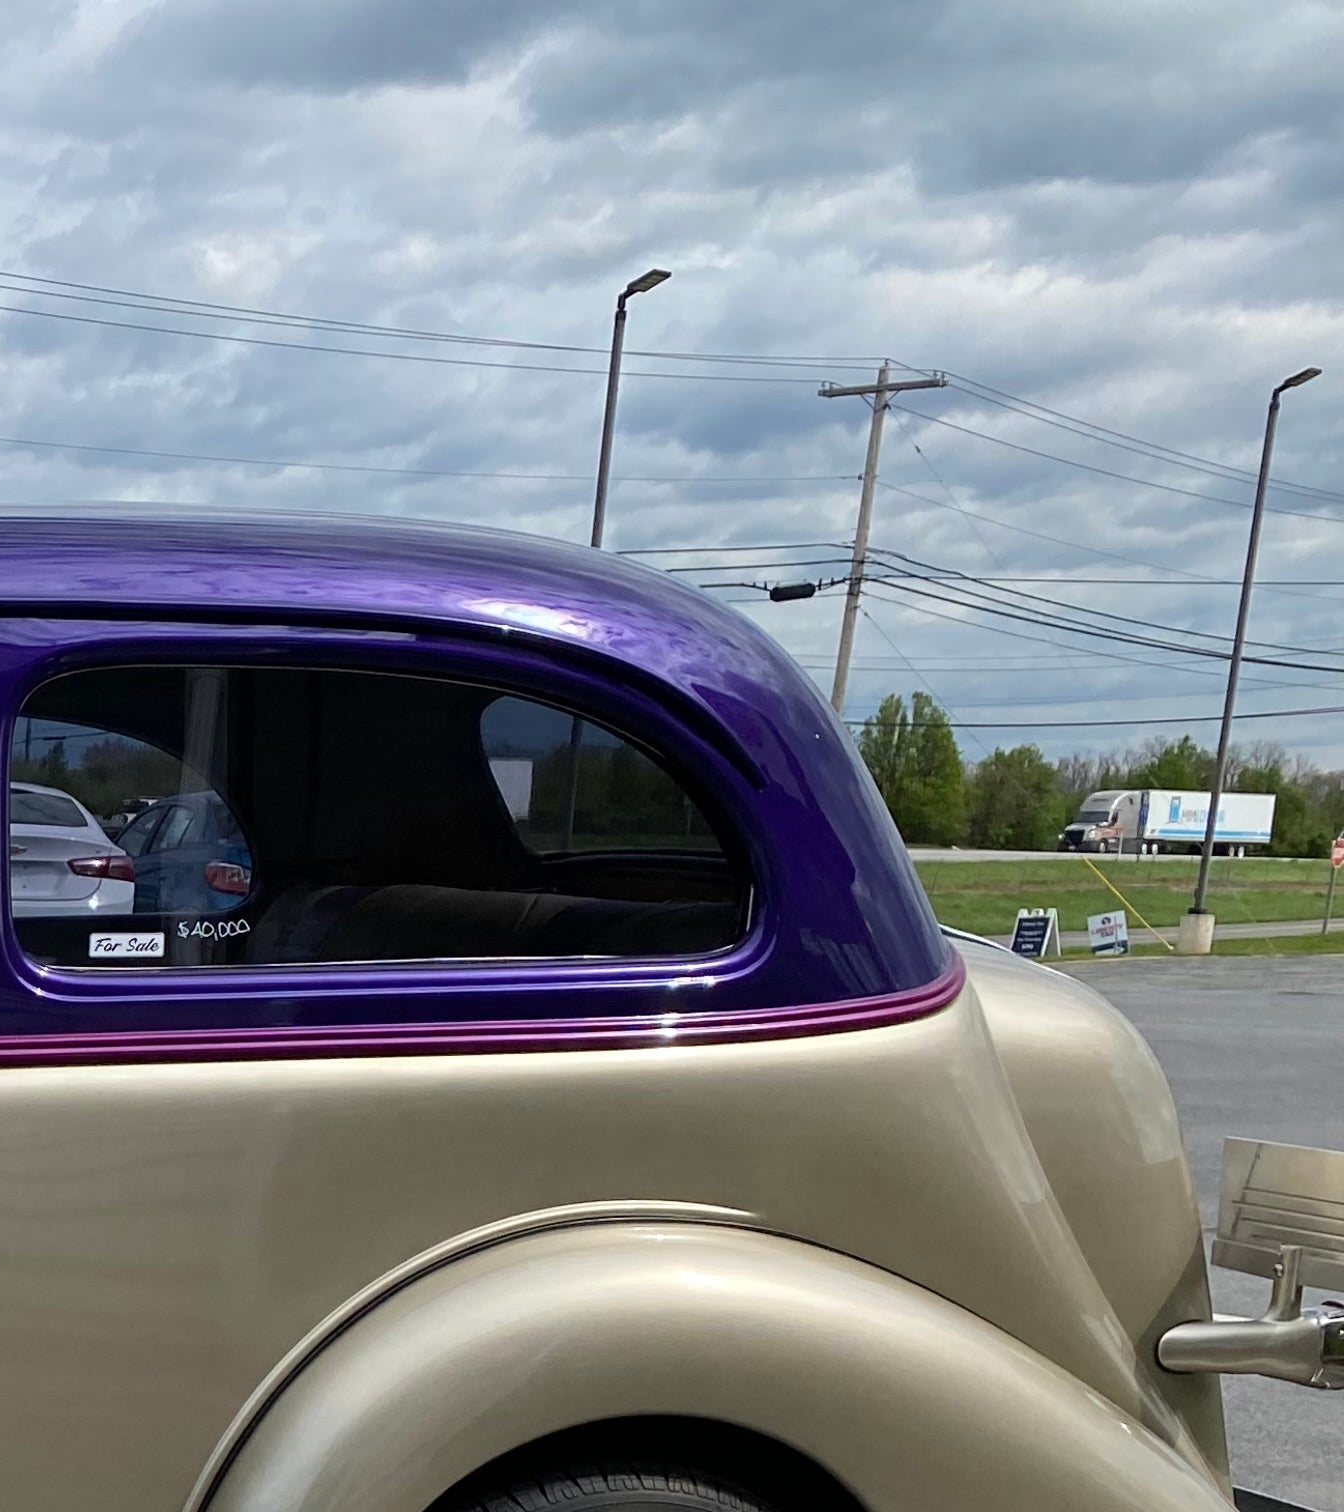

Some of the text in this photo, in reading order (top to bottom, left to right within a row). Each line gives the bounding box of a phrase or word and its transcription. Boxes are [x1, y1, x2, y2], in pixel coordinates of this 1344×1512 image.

[176, 919, 251, 941] $40,000
[94, 937, 160, 952] For Sale
